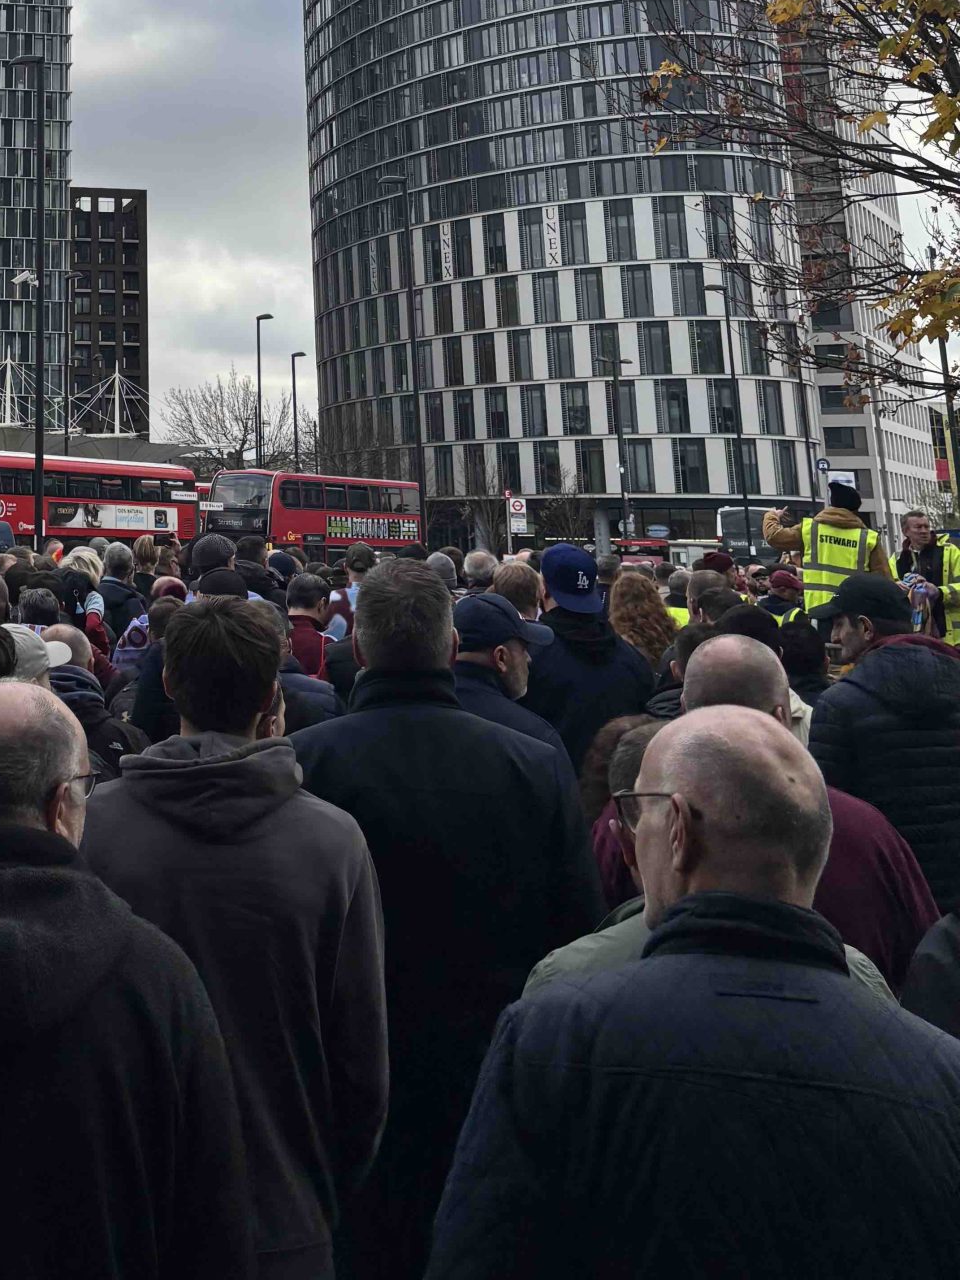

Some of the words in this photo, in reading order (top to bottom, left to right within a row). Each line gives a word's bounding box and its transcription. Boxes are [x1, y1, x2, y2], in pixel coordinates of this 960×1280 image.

[545, 207, 559, 265] UNEX
[442, 224, 453, 278] UNEX
[369, 242, 378, 291] UNEX
[505, 490, 511, 498] E
[218, 519, 243, 527] Stratford
[819, 534, 858, 549] STEWARD
[577, 571, 590, 589] LA
